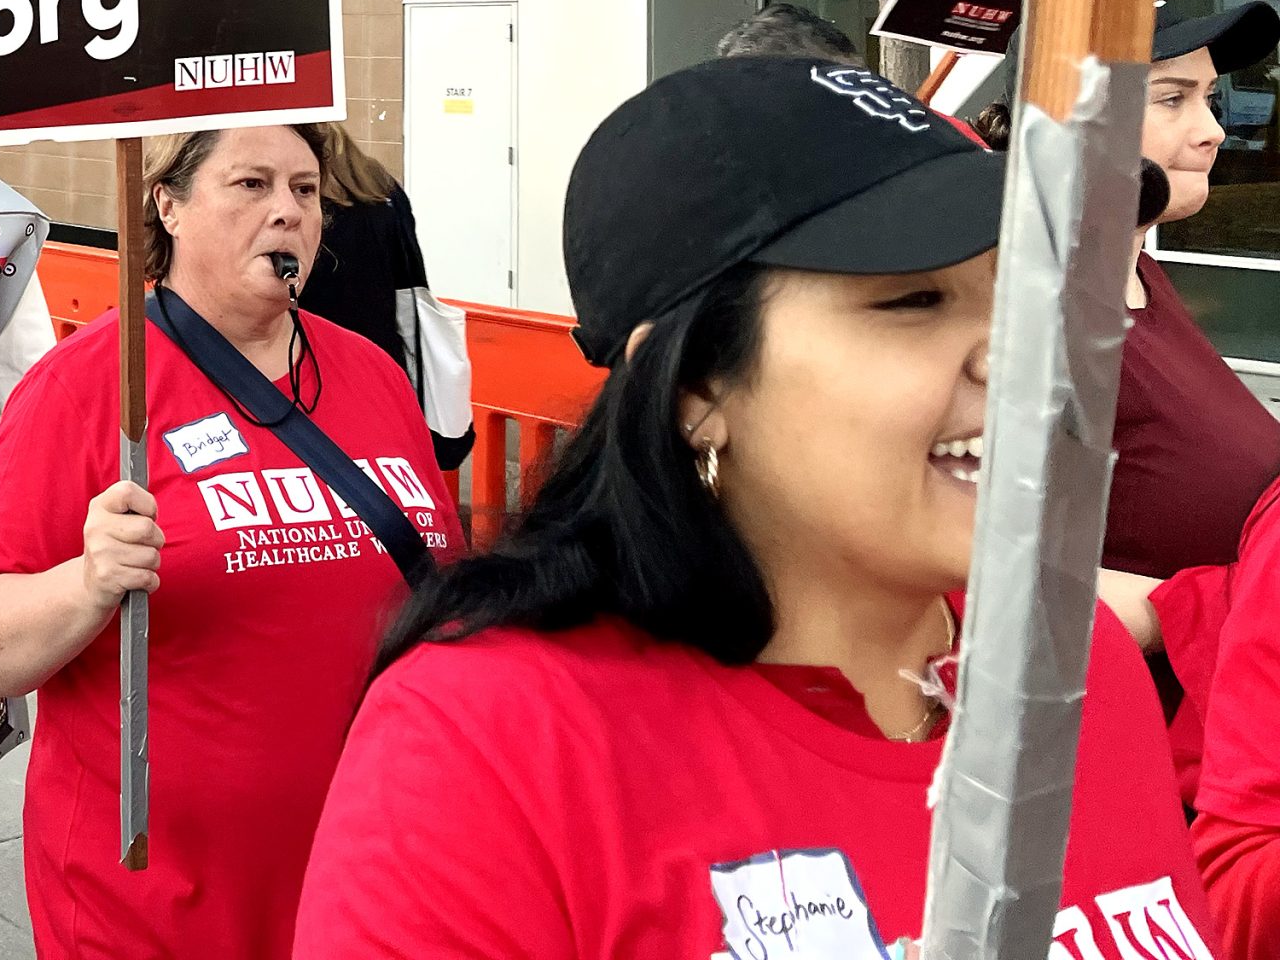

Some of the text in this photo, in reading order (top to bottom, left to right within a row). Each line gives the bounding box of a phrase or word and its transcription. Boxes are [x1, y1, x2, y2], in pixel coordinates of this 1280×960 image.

[175, 52, 294, 90] NUHW
[446, 88, 472, 96] STAIR 7
[182, 429, 232, 458] Bridget
[206, 462, 426, 521] NUW
[237, 524, 342, 550] NATIONAL
[415, 511, 433, 527] OF
[224, 541, 361, 574] HEALTHCARE
[737, 891, 853, 960] Stephanie
